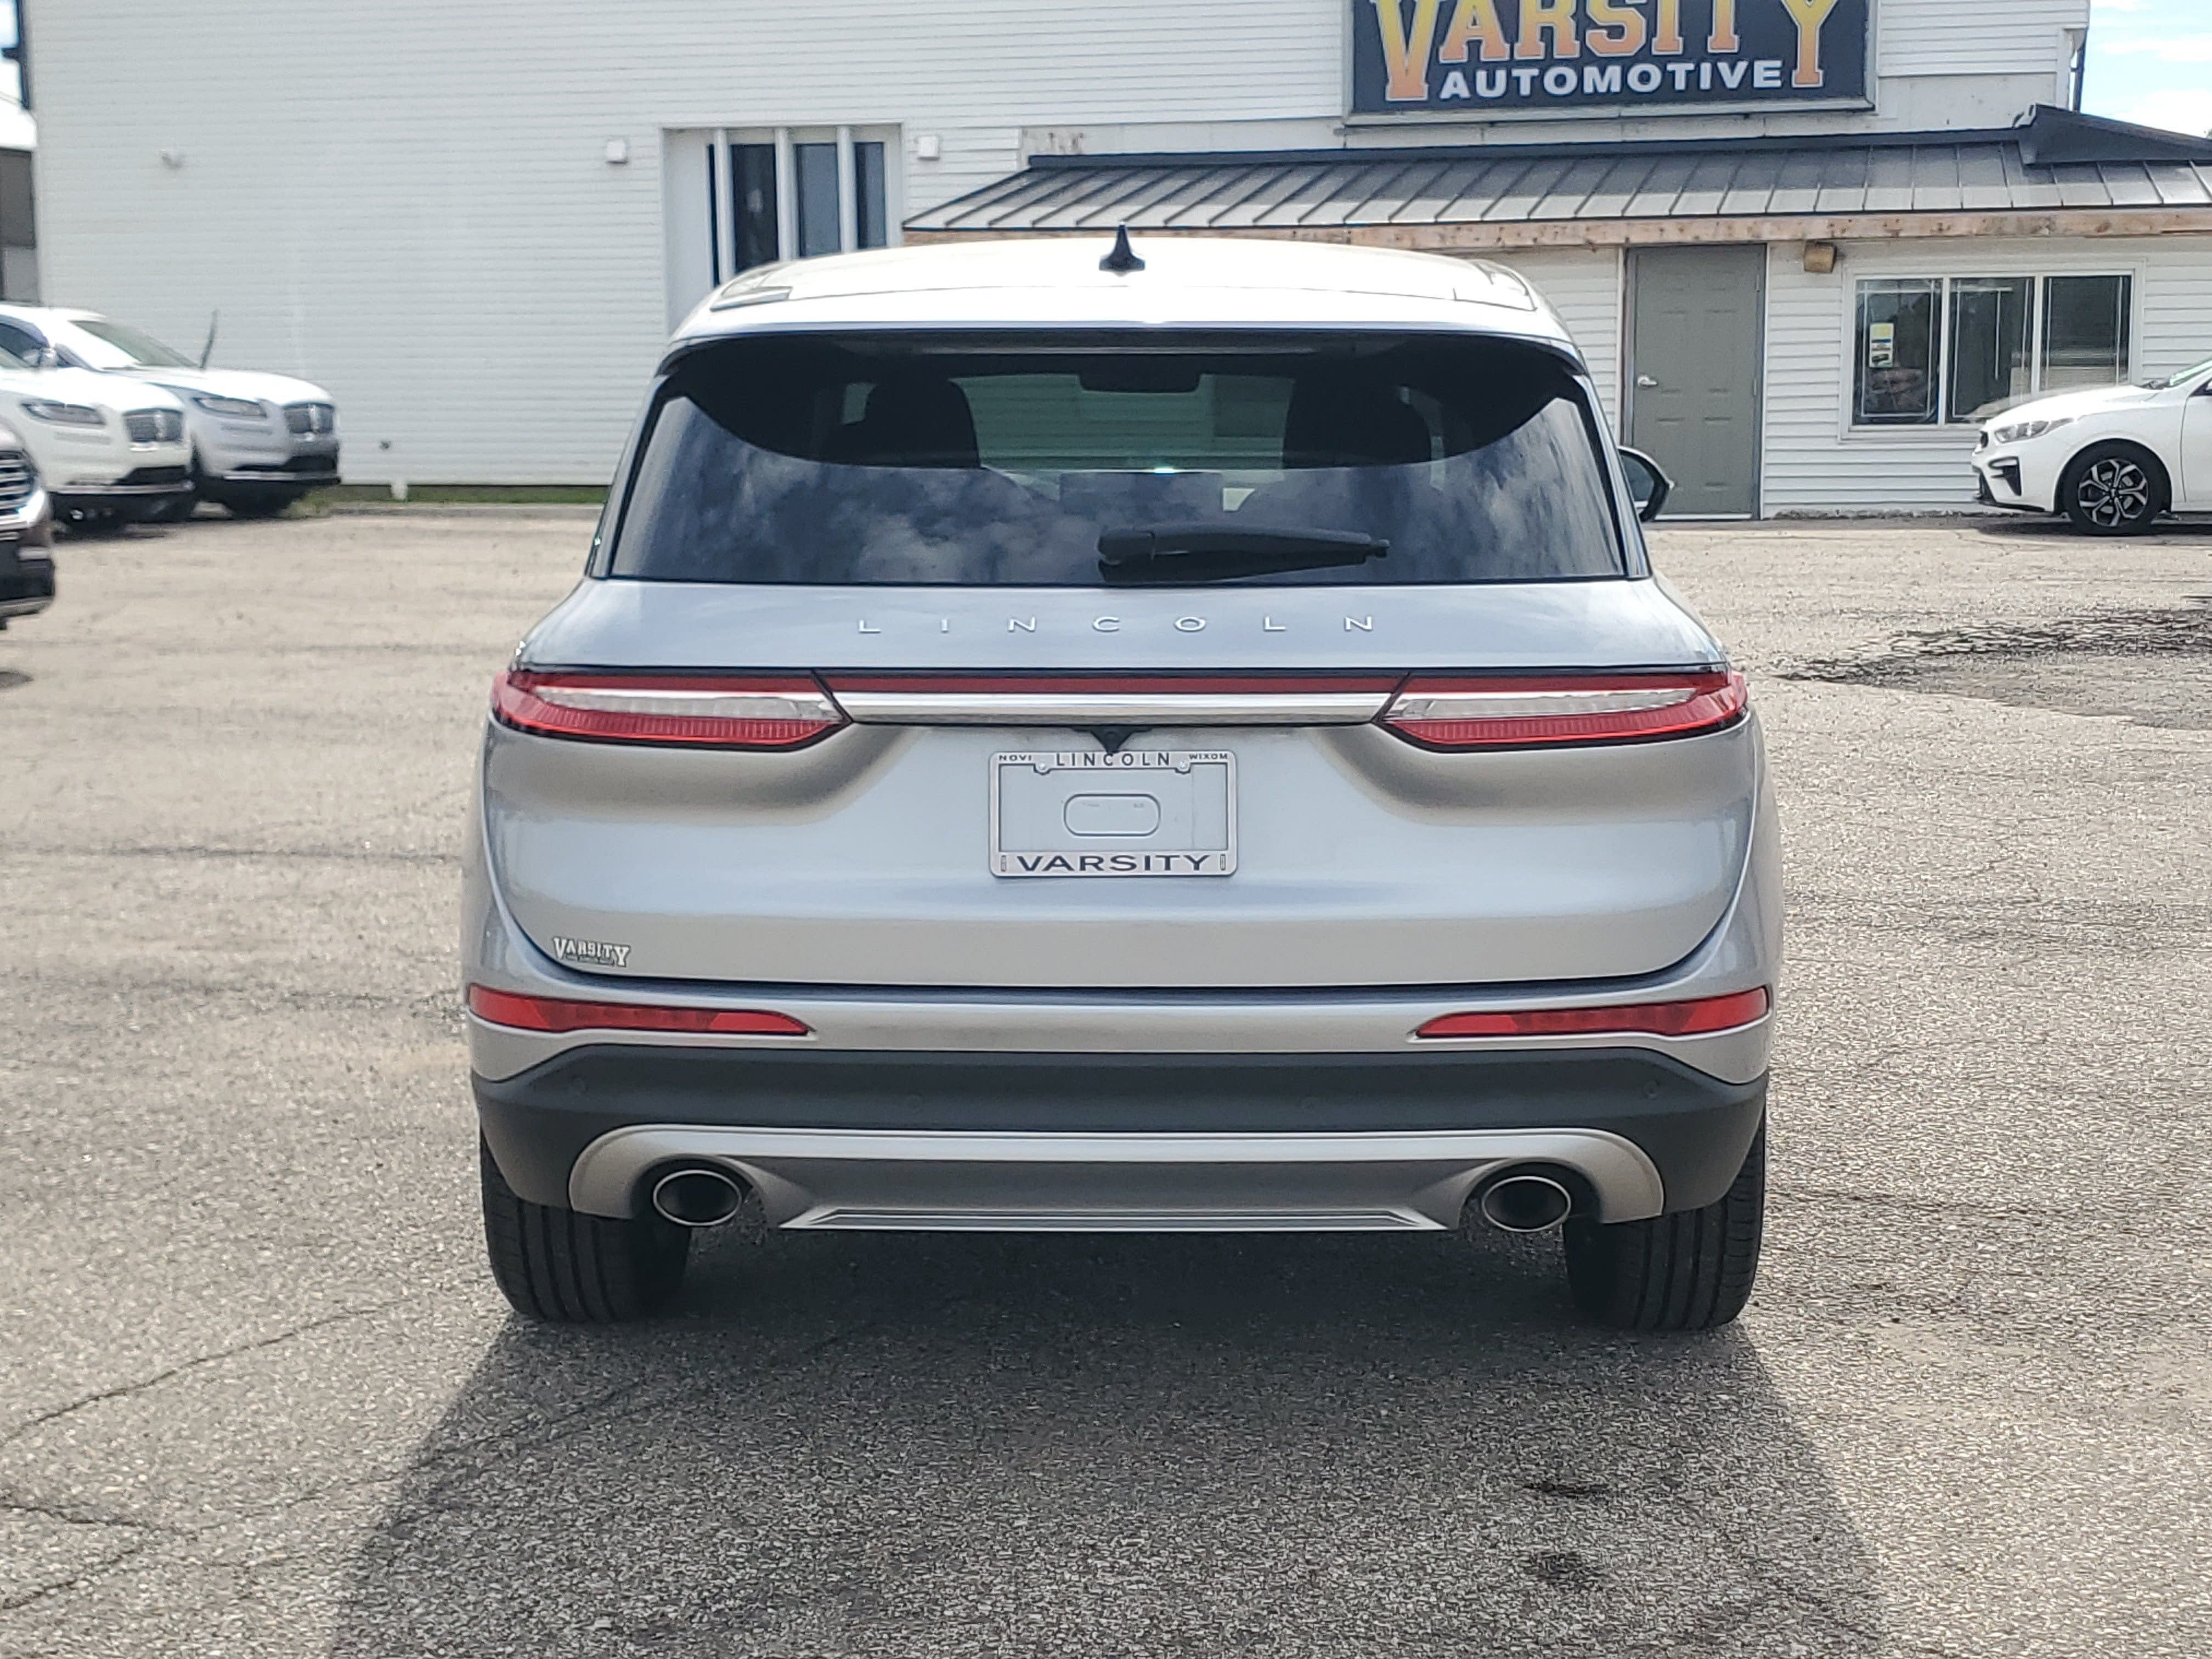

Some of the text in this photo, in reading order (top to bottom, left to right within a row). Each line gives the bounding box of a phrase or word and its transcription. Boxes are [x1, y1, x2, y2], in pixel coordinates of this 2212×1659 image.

[1439, 60, 1782, 99] AUTOMOTIVE
[859, 616, 1373, 634] LINCOLN
[1056, 752, 1170, 766] LINCOLN
[1017, 855, 1210, 872] VARSITY
[552, 936, 630, 967] VARSITY
